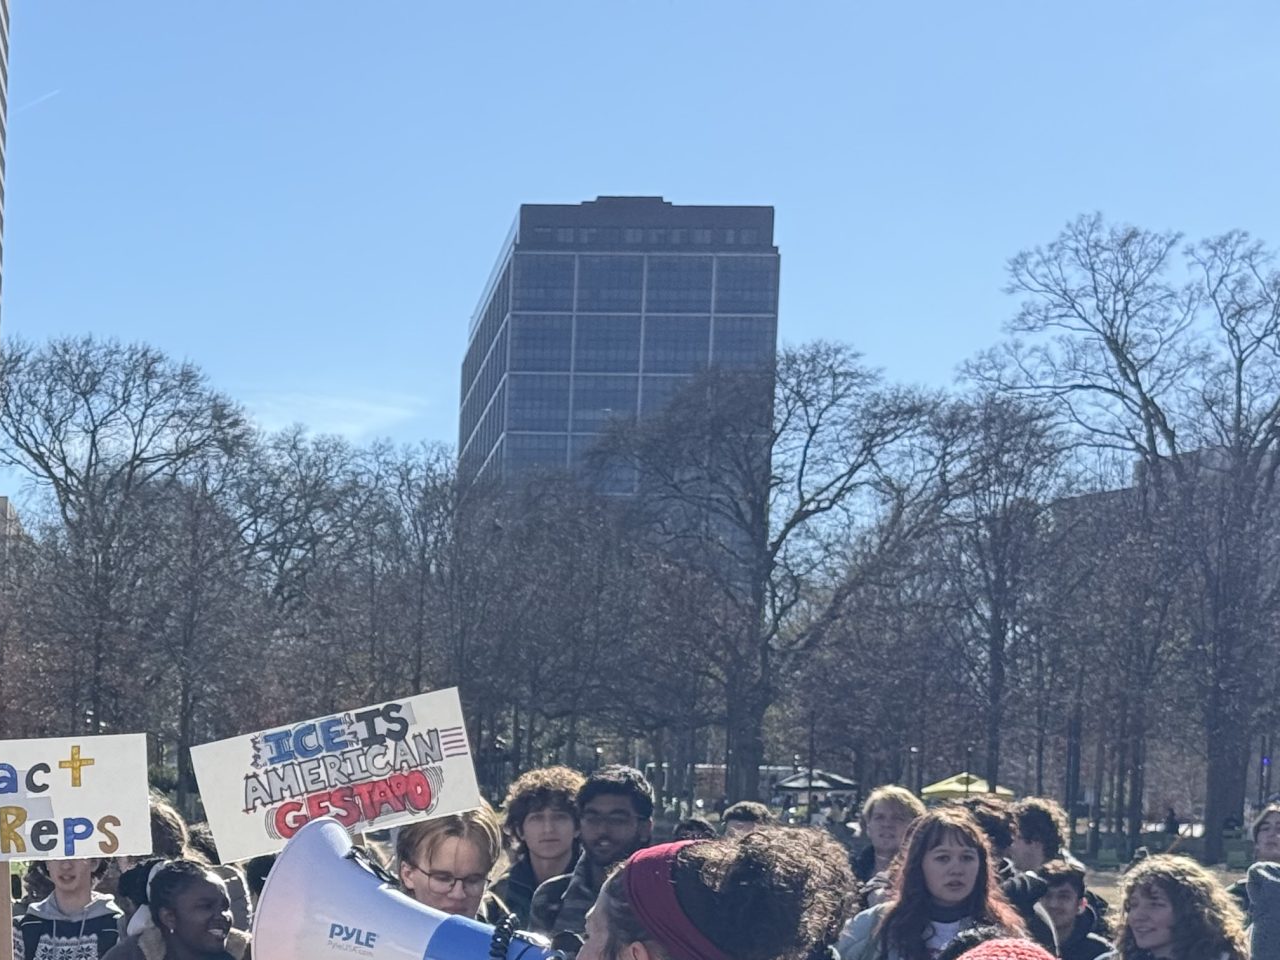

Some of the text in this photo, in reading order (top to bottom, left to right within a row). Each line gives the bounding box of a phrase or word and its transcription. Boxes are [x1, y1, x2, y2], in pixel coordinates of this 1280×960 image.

[263, 703, 409, 765] ICE IS
[244, 728, 443, 813] AMERICAN
[275, 770, 431, 839] GESTAPO
